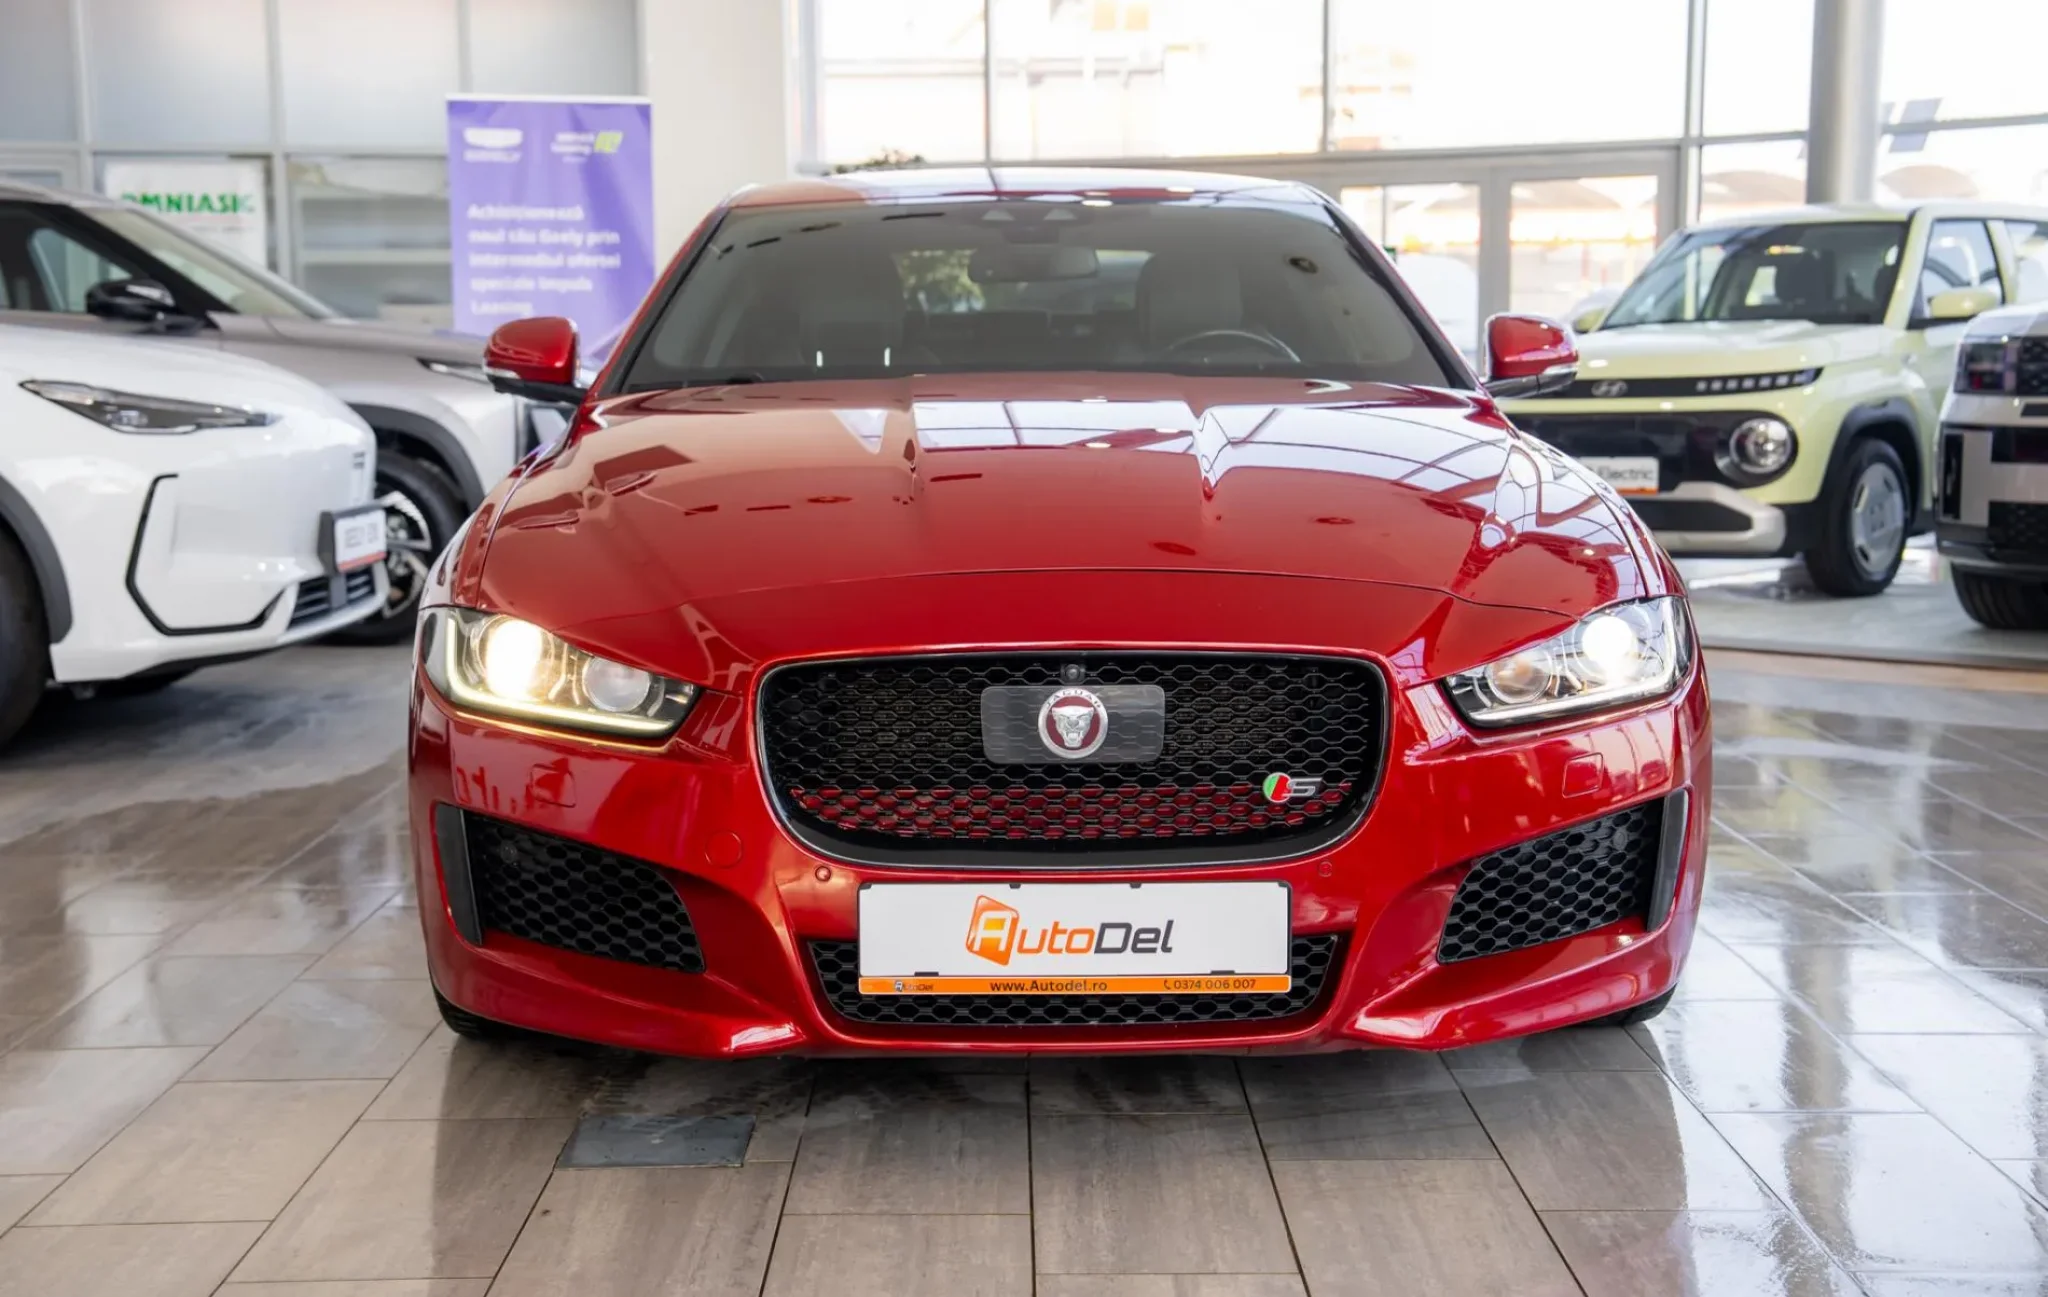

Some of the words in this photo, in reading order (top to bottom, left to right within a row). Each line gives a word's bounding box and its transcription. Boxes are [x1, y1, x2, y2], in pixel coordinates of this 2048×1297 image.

[1598, 466, 1653, 480] Electric
[968, 904, 1174, 956] AutoDel
[989, 979, 1108, 992] www.Autodel.ro
[1173, 979, 1201, 990] 0374
[1205, 979, 1230, 989] 006
[1233, 979, 1257, 989] 007
